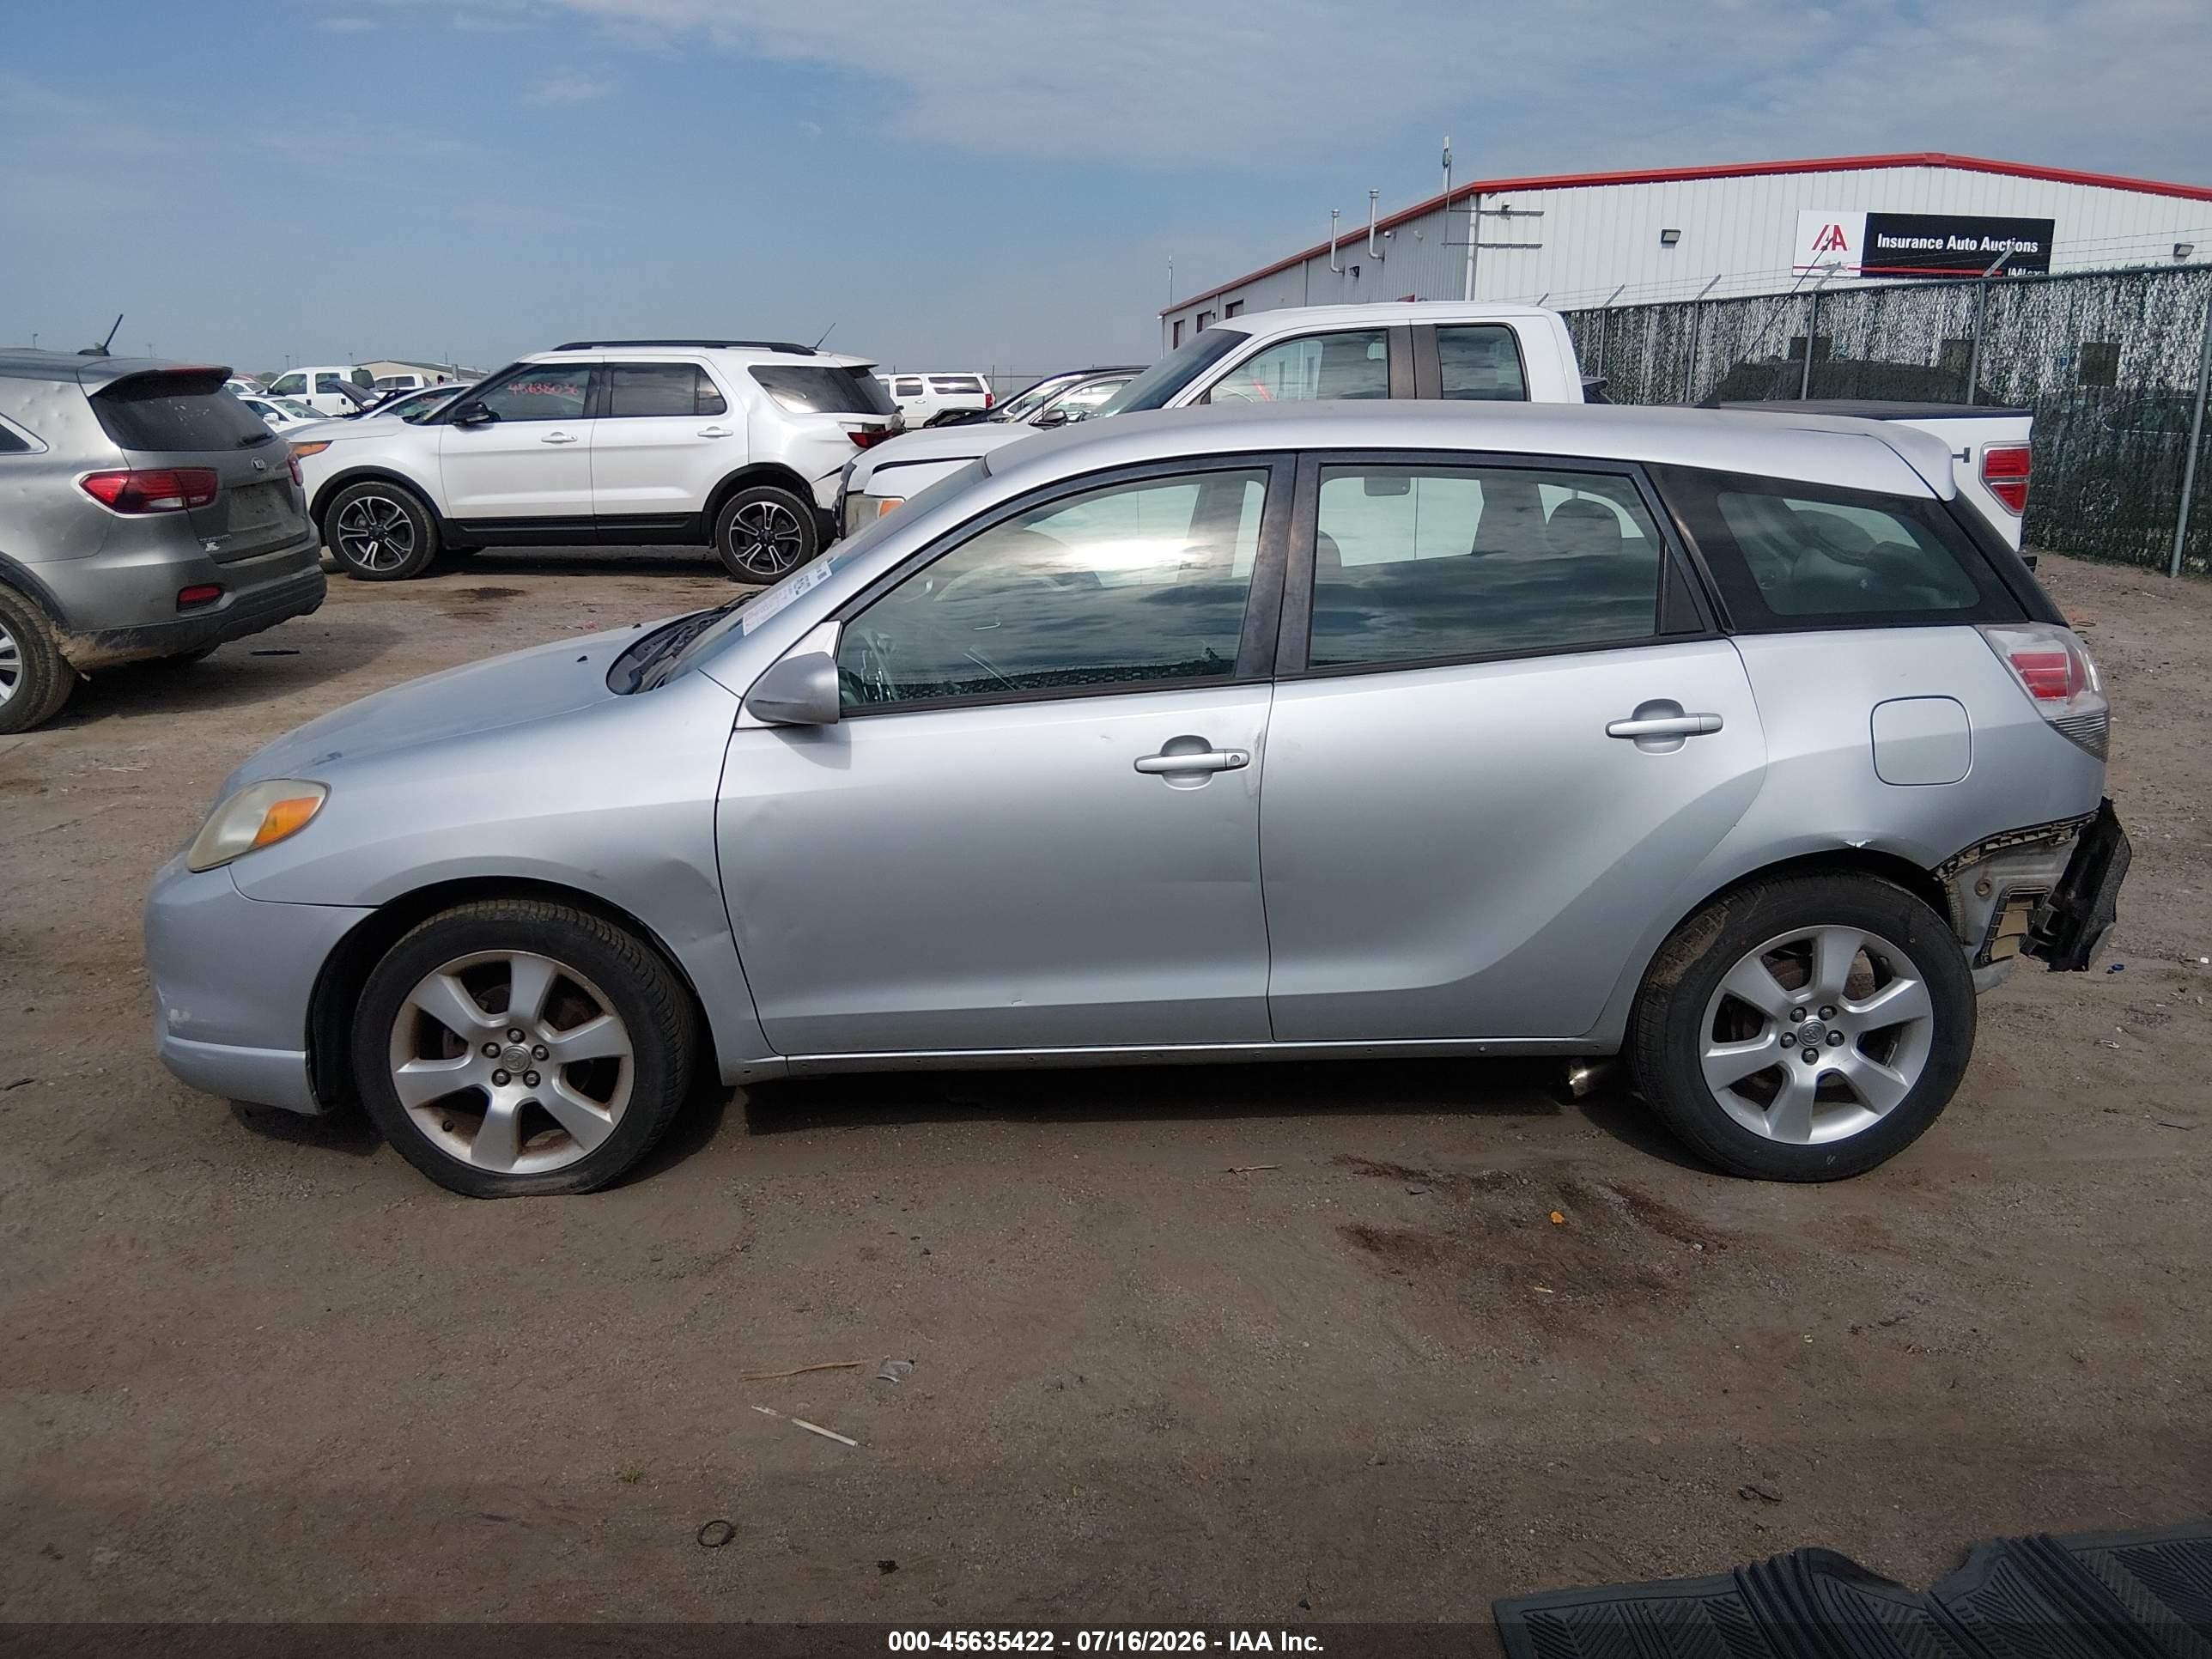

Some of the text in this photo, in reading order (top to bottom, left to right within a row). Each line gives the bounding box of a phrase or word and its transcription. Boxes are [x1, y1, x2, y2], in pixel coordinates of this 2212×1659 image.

[1877, 233, 2039, 253] Insurance Auto Auctions
